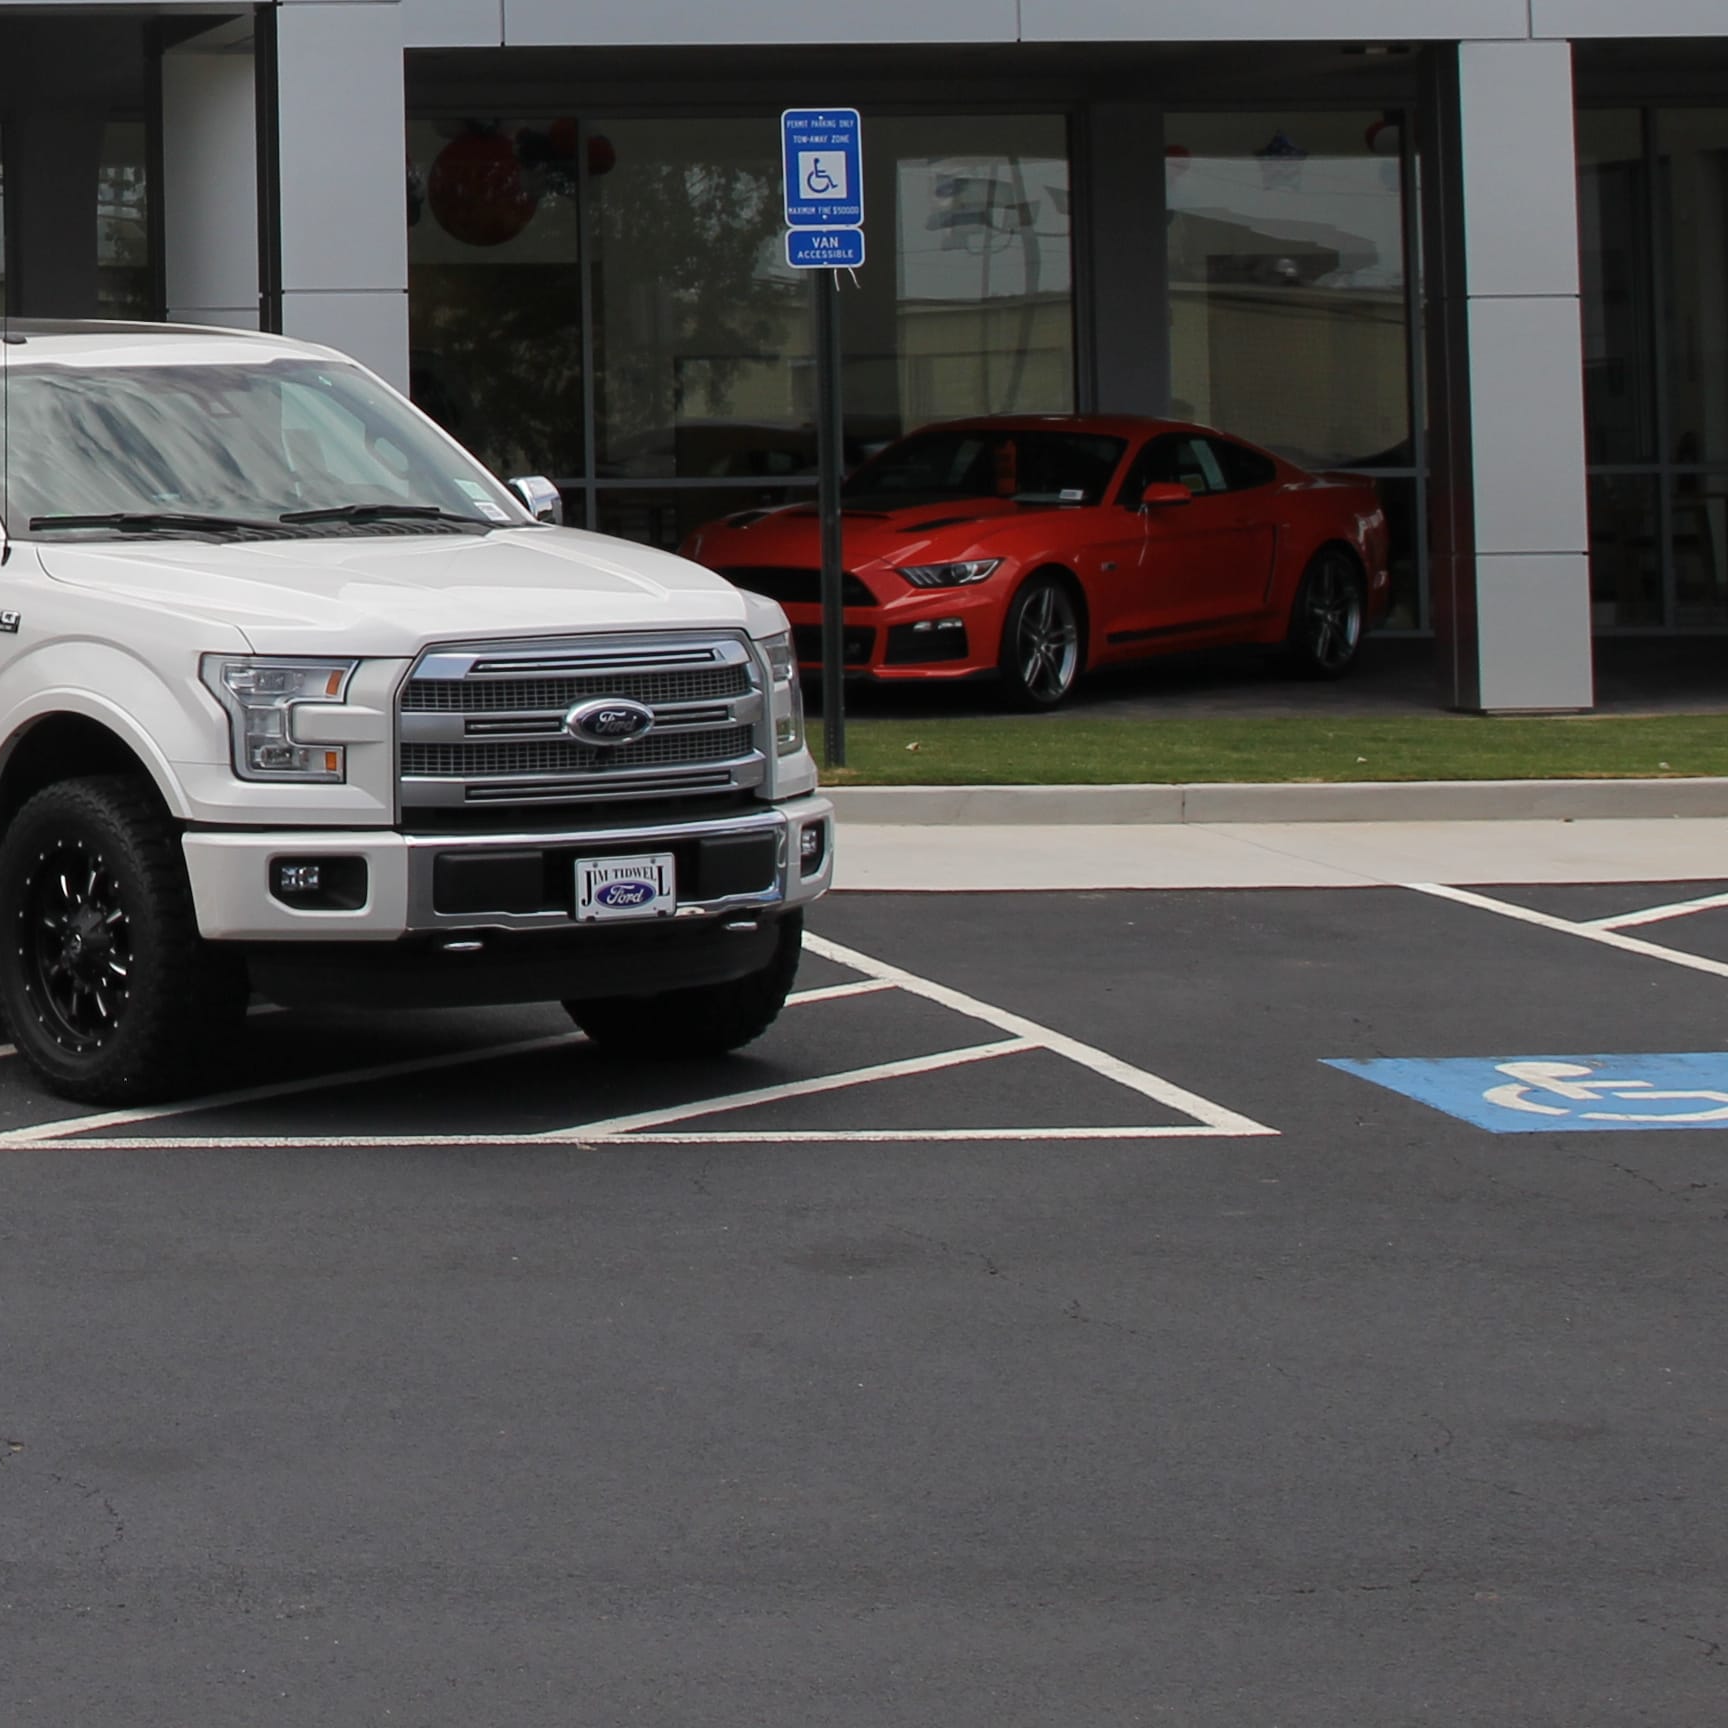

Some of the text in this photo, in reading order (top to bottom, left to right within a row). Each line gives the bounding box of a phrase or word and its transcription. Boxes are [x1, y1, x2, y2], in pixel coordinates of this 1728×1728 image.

[786, 120, 854, 129] PERMIT PARKING ONLY
[831, 133, 850, 144] ZONE
[788, 206, 816, 215] MAXIMUM
[818, 206, 832, 215] FINE
[812, 236, 839, 249] VAN
[797, 249, 854, 259] ACCESSIBLE
[595, 711, 638, 733] Ford
[581, 864, 671, 907] JIM TIDWELL
[606, 884, 645, 905] Ford
